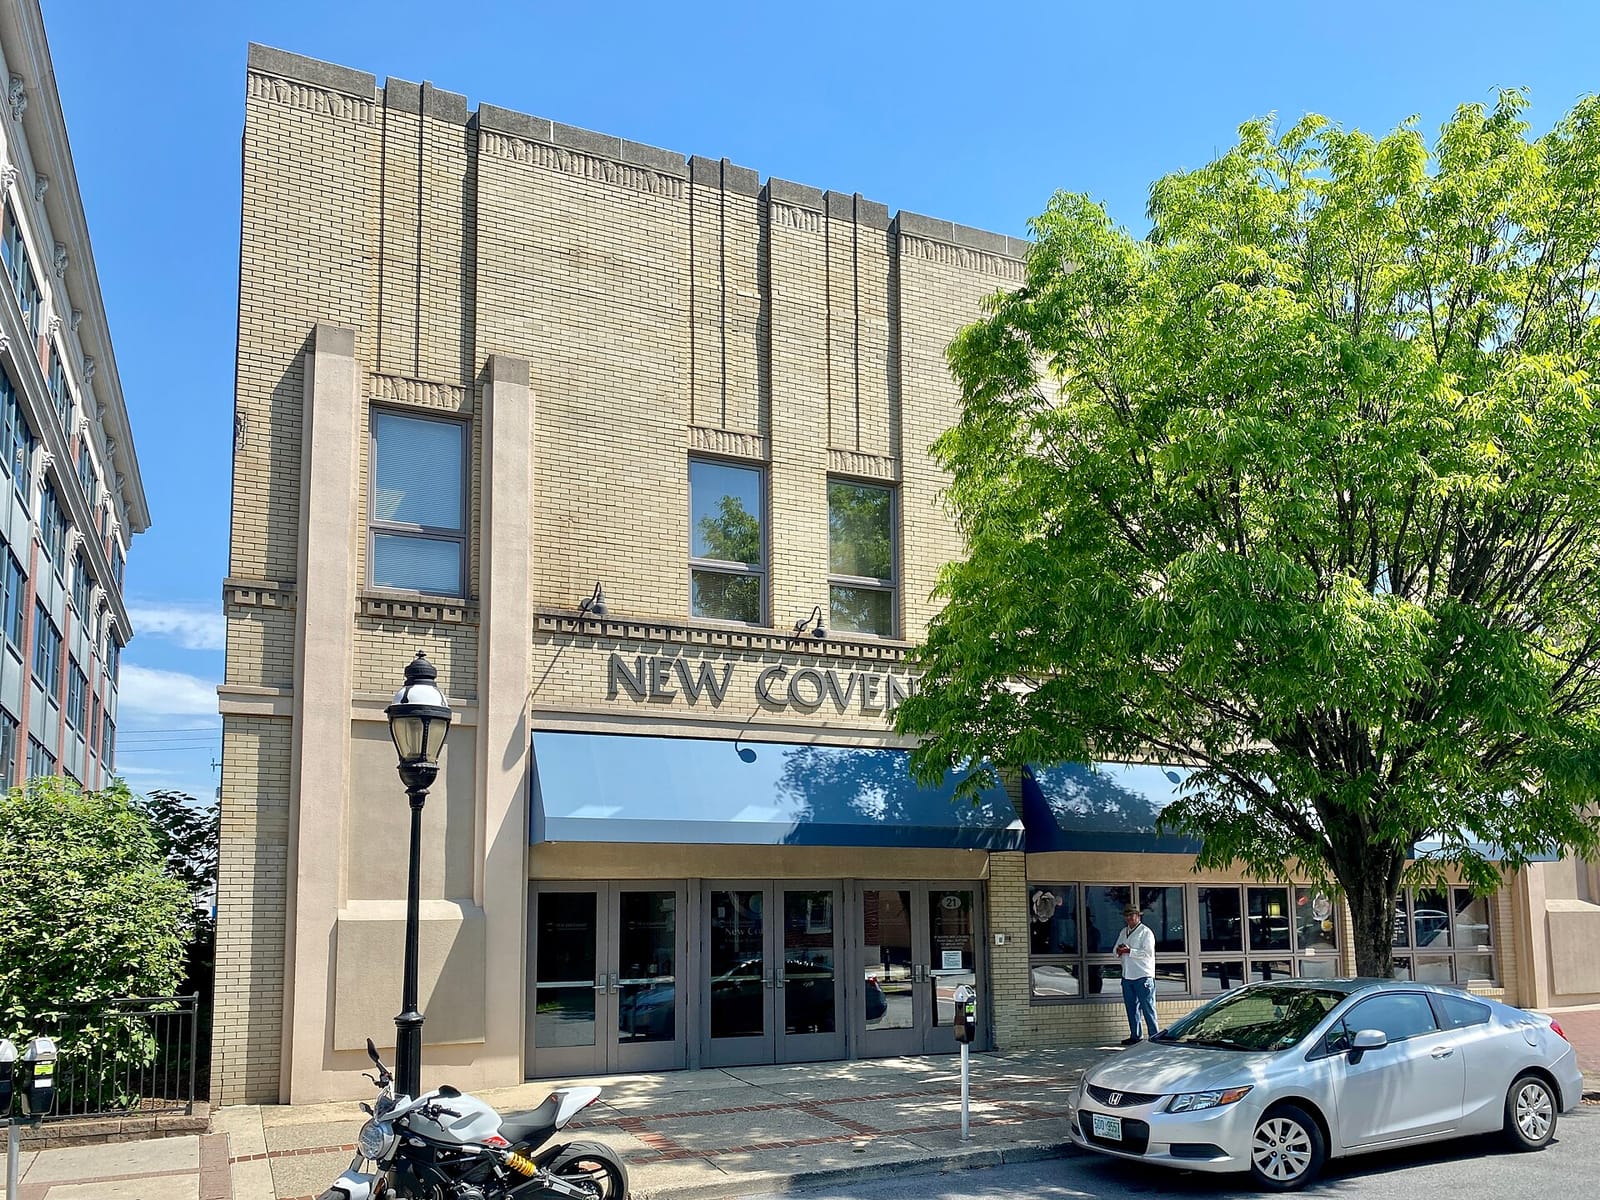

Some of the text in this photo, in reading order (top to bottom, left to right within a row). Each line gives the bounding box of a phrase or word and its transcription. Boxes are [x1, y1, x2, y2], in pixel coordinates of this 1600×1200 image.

[609, 653, 922, 711] NEW COVEN
[946, 898, 957, 907] 21
